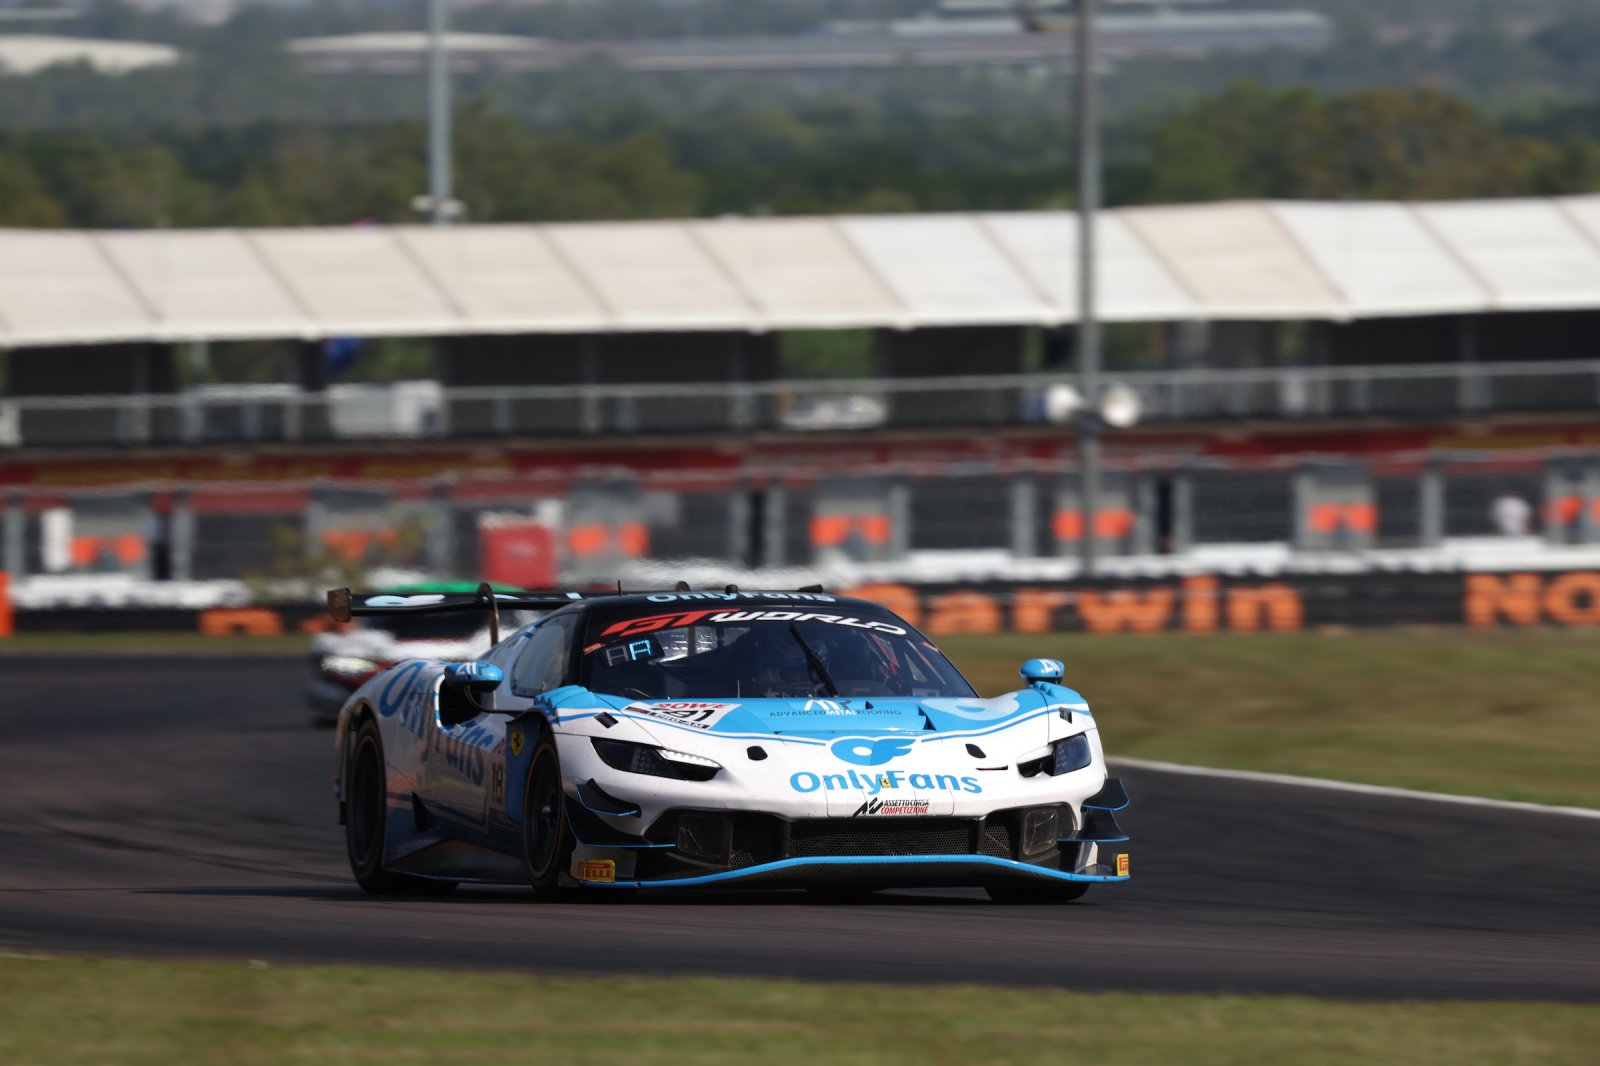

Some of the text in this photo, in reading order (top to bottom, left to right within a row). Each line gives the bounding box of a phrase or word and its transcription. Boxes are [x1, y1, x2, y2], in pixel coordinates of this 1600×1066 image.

[601, 609, 907, 637] GT WORLD
[790, 770, 983, 796] OnlyFans
[881, 806, 929, 815] COMPETIZIONE
